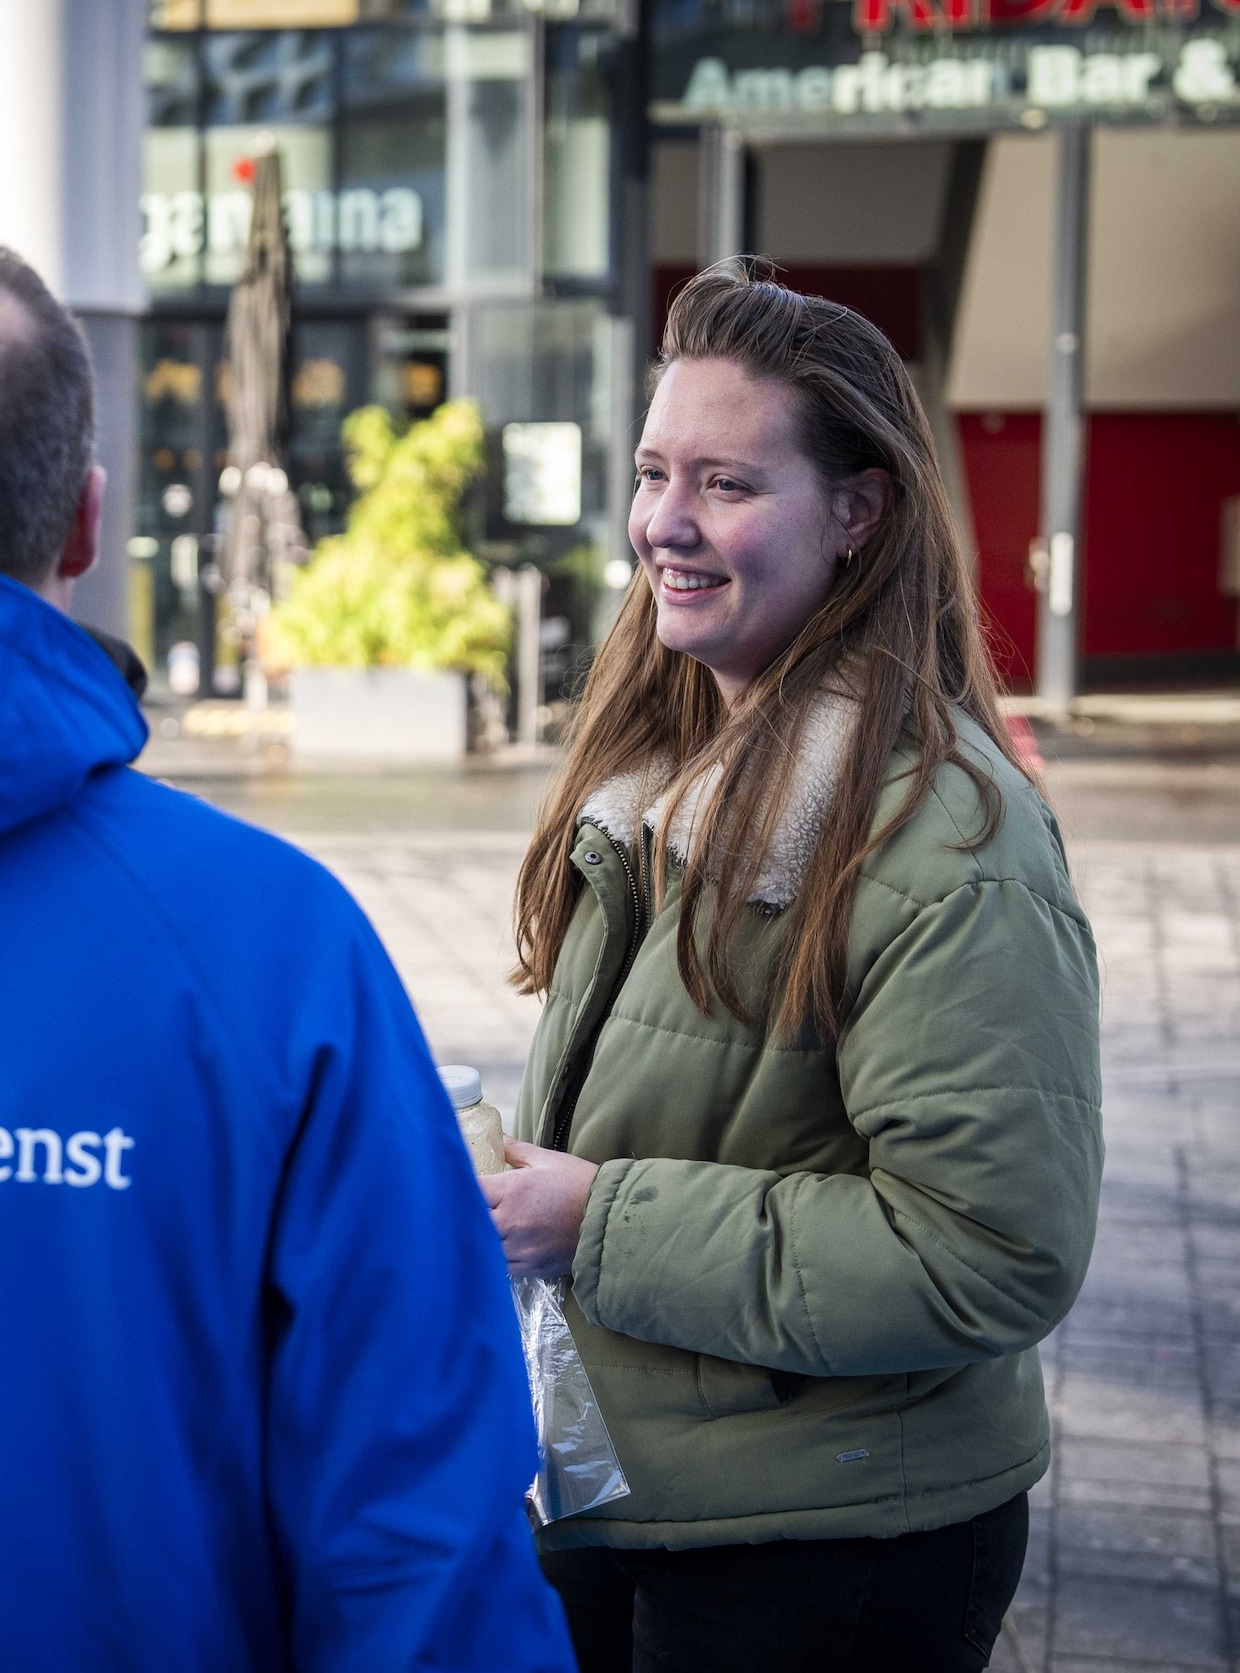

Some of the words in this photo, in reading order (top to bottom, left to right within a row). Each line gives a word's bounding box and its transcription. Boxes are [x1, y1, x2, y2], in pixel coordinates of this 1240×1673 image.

[683, 52, 1008, 112] American
[1027, 44, 1162, 104] Bar
[1173, 38, 1238, 104] &
